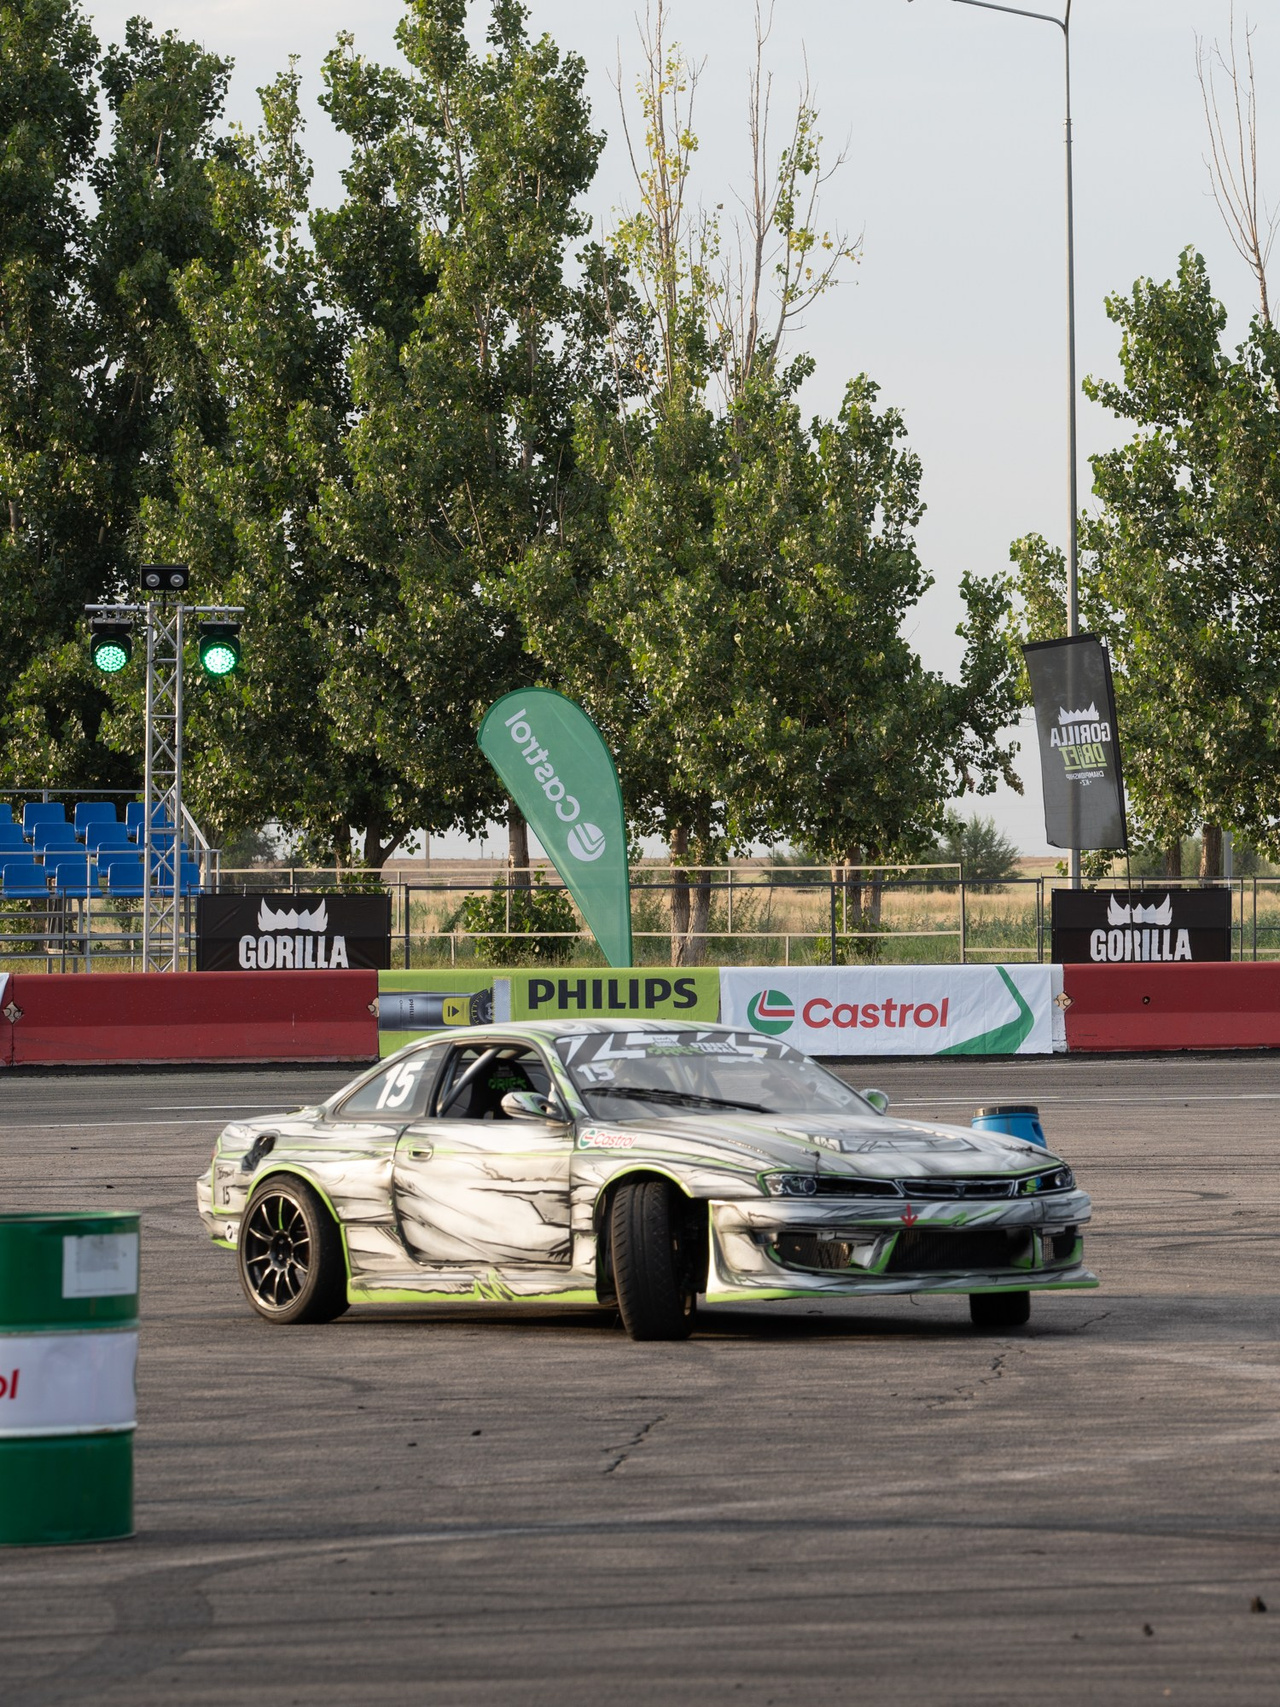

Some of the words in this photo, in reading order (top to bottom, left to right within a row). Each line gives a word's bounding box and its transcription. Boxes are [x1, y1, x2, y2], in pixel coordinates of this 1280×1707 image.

[238, 935, 350, 969] GORILLA
[1090, 928, 1193, 961] GORILLA
[528, 978, 698, 1009] PHILIPS
[802, 997, 949, 1028] Castrol
[376, 1061, 425, 1109] 15
[576, 1062, 616, 1082] 15
[594, 1132, 638, 1147] Castrol
